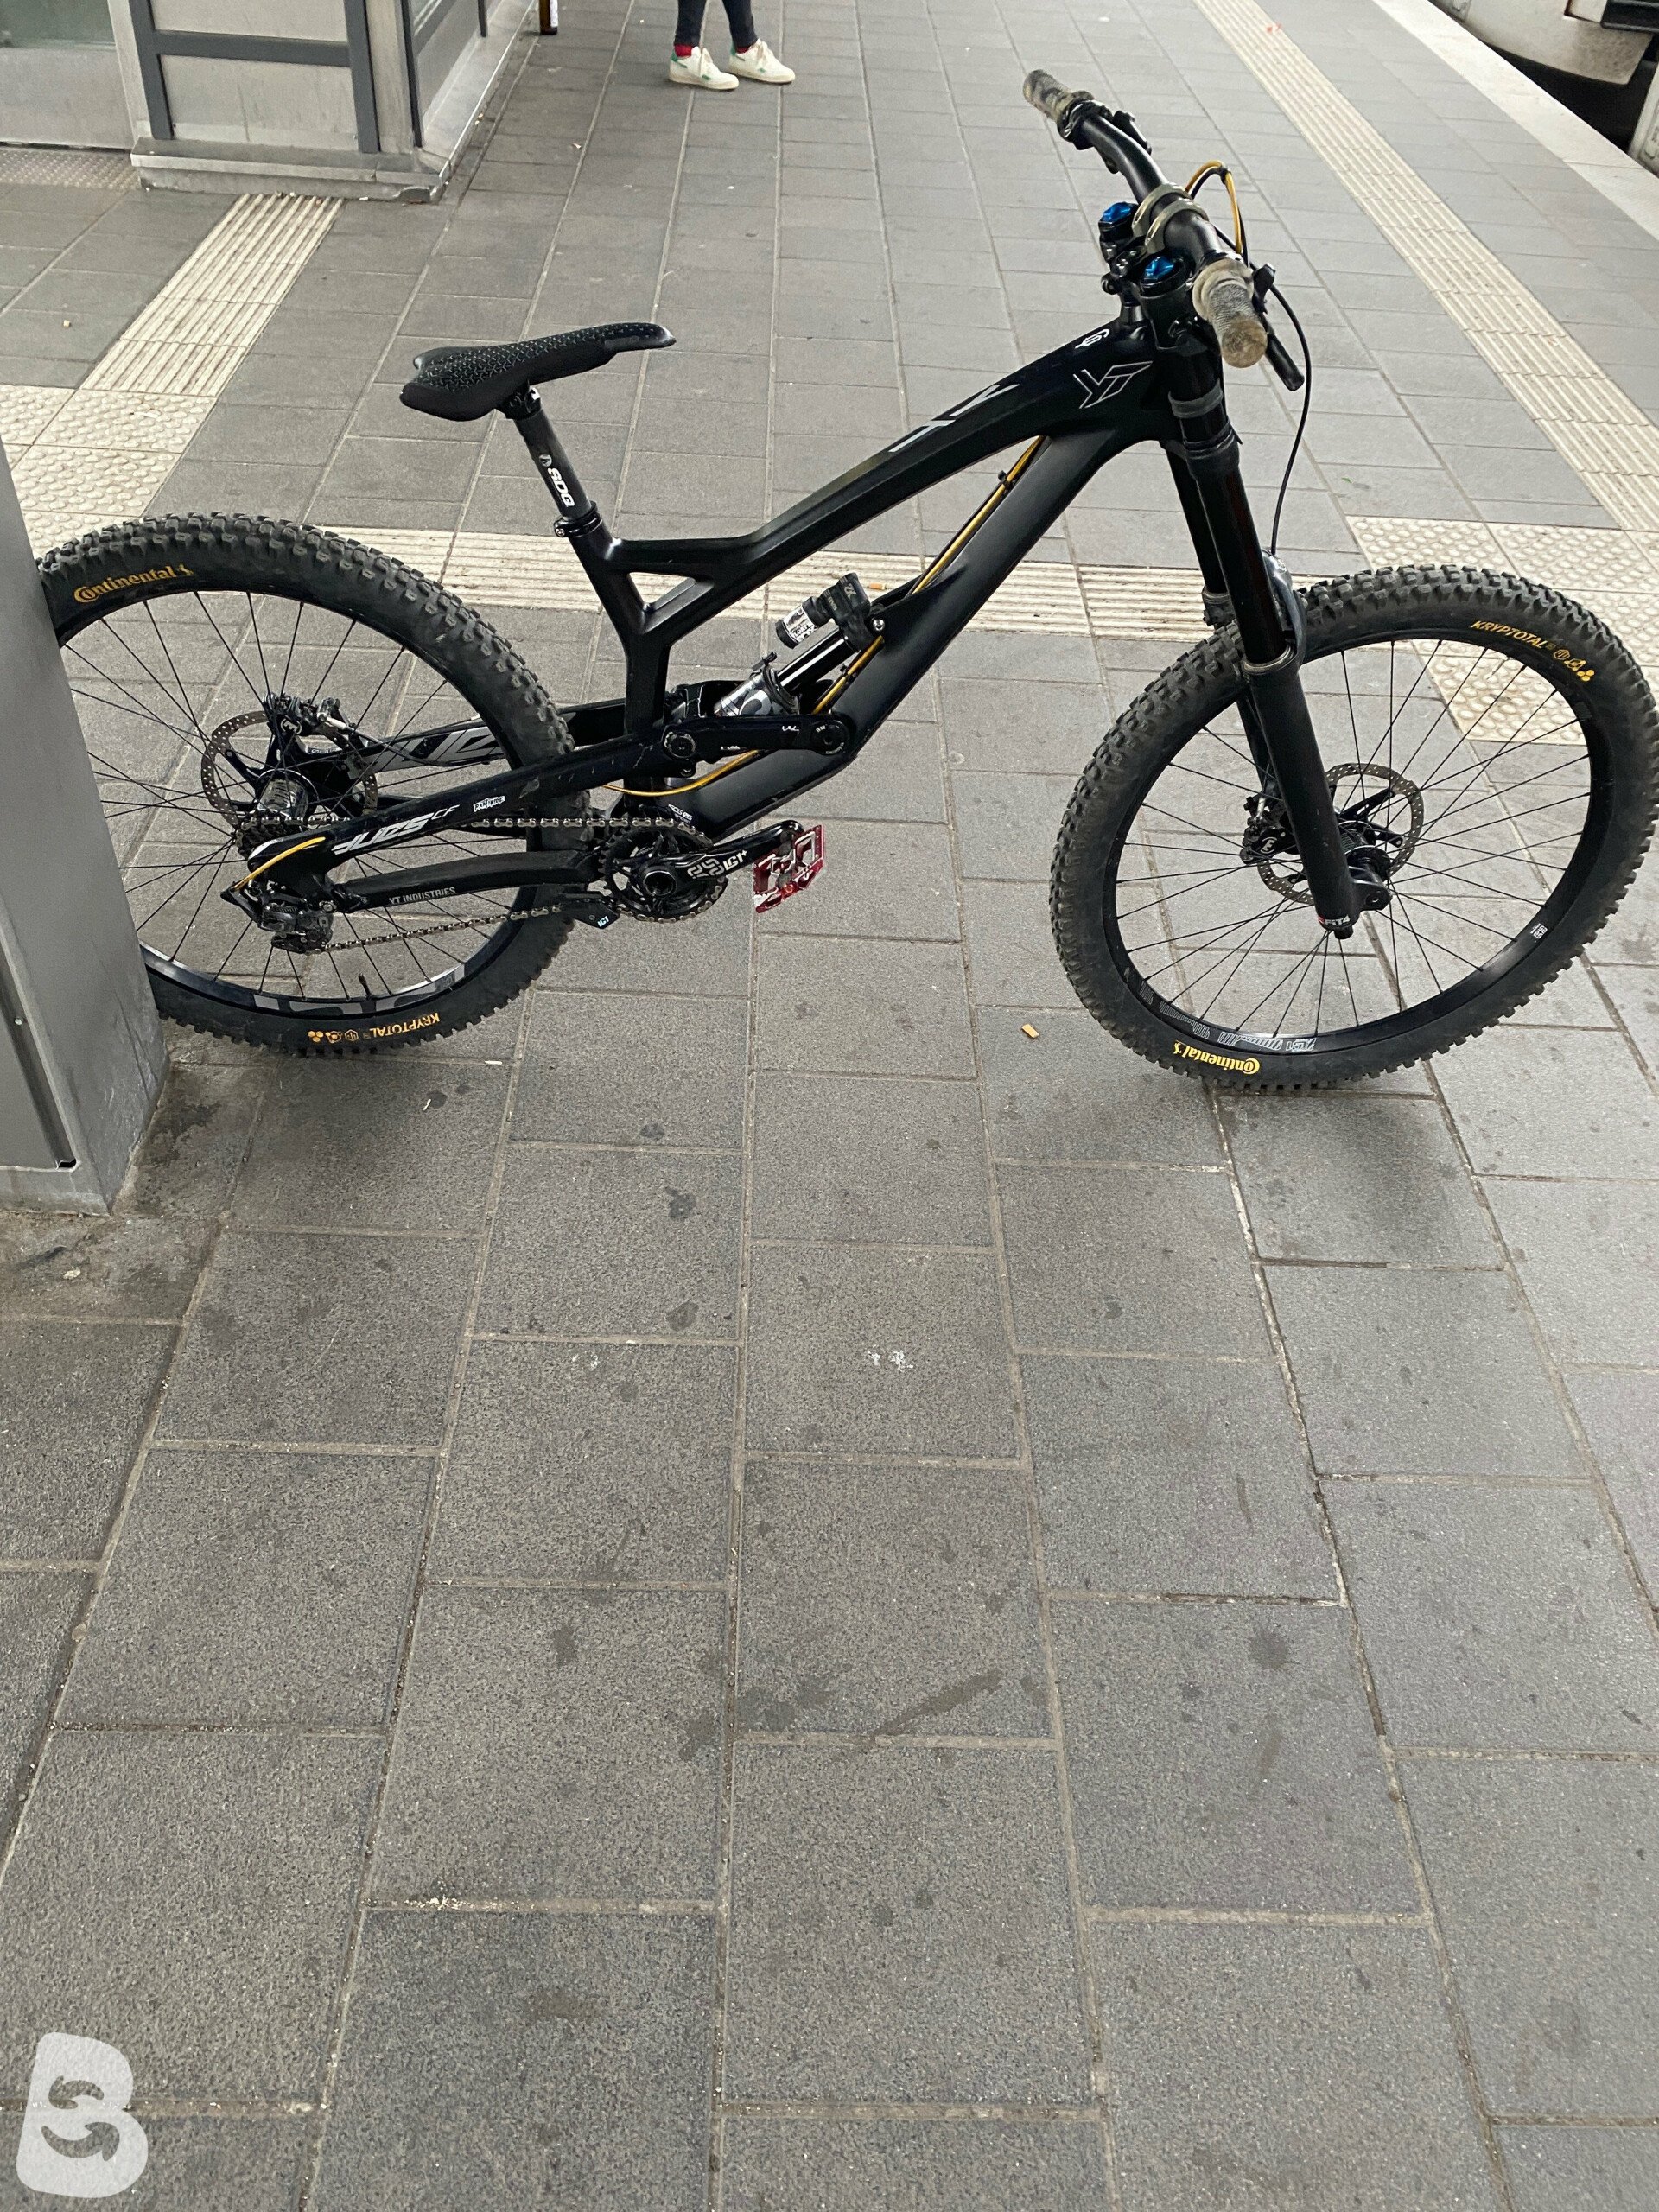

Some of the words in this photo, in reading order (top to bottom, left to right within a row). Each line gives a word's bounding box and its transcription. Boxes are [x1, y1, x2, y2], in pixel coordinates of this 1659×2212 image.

[1072, 360, 1154, 410] YT
[547, 467, 575, 508] SDG
[73, 565, 177, 603] Continental
[1470, 620, 1548, 649] KRYPTOTAL
[431, 804, 461, 821] CF
[388, 894, 401, 905] YT
[403, 887, 456, 904] INDUSTRIES
[369, 1012, 441, 1038] KRYPTOTAL
[1181, 1043, 1261, 1075] Continental
